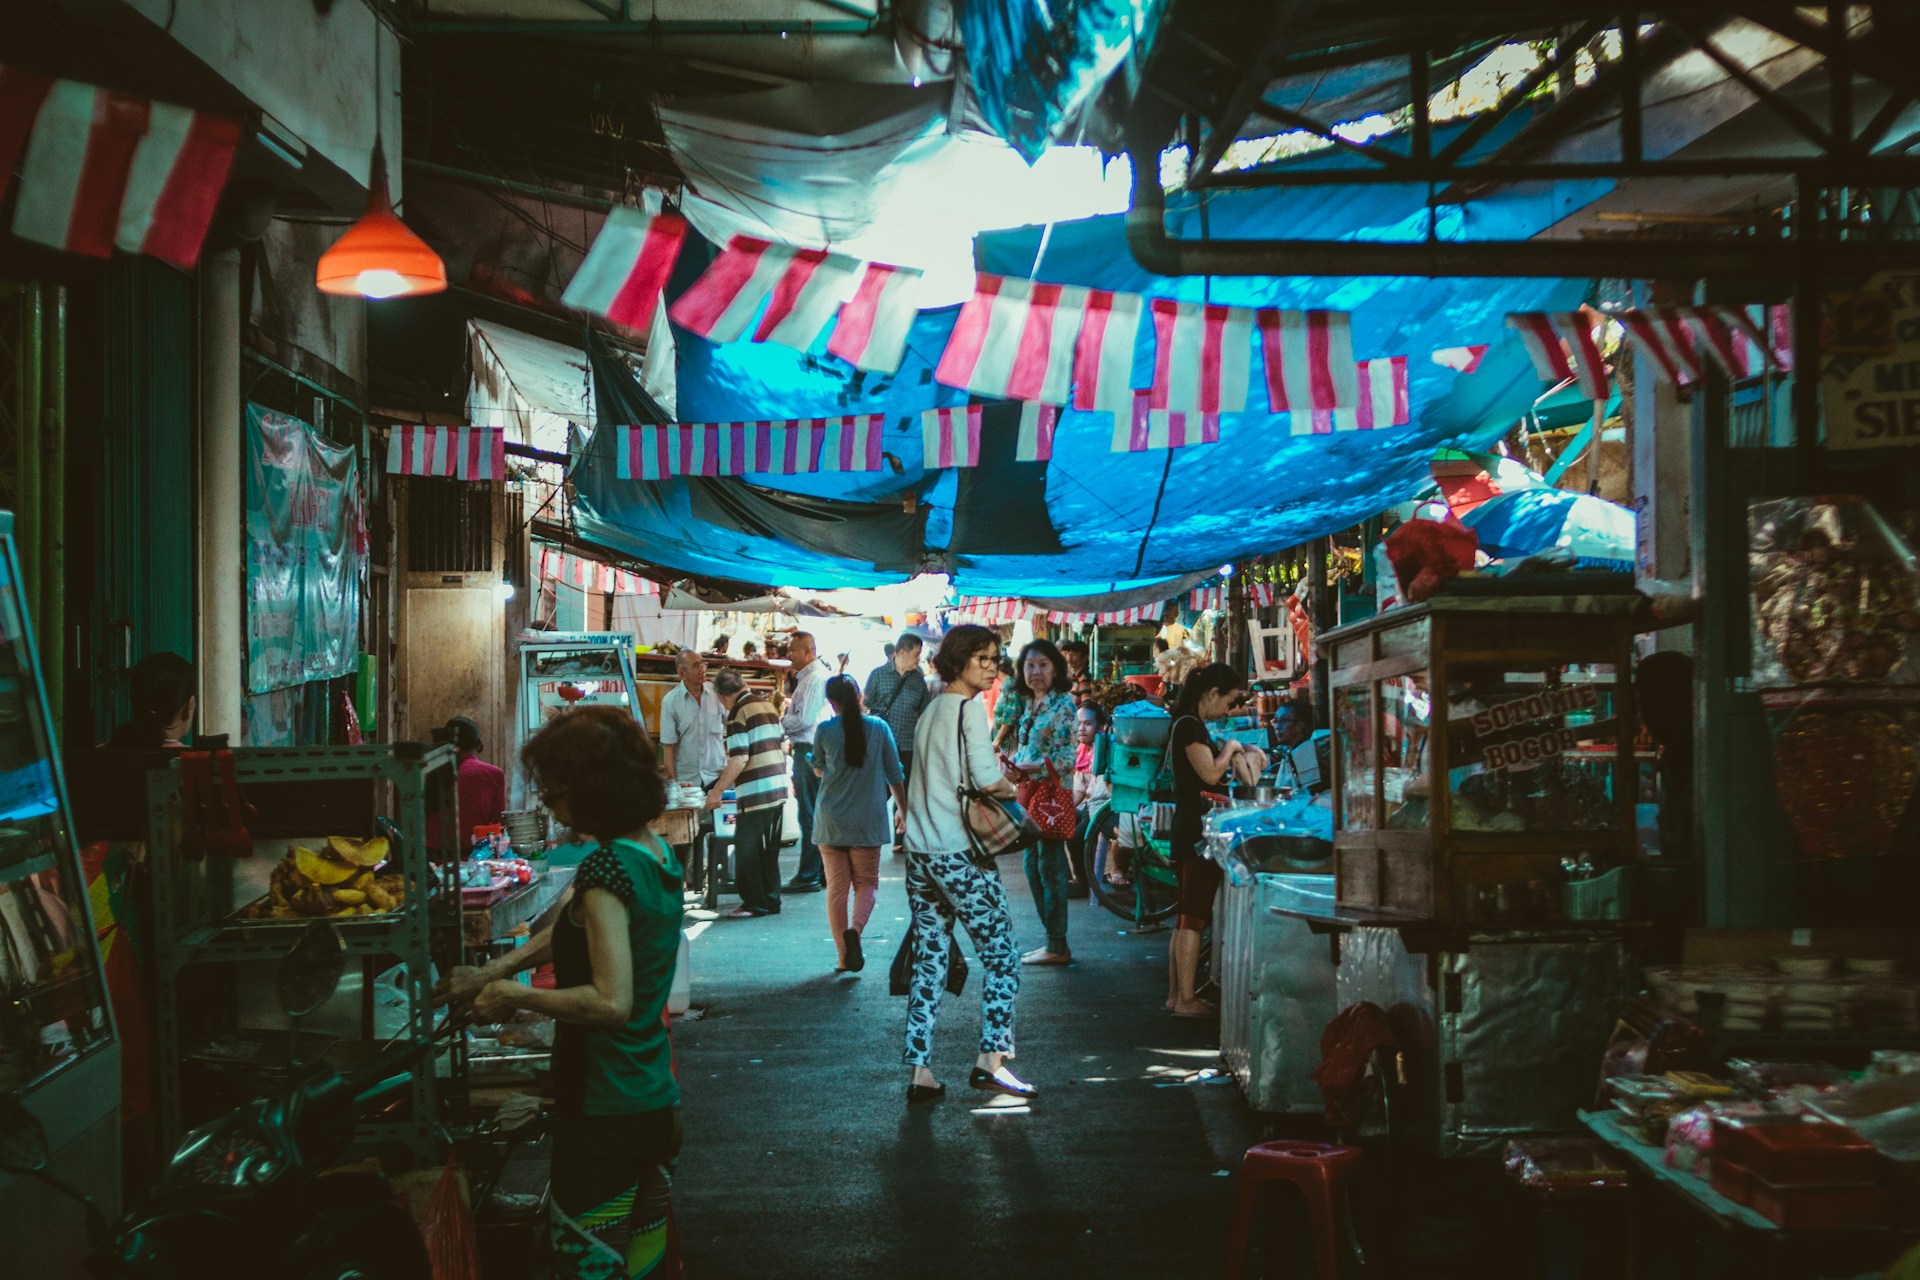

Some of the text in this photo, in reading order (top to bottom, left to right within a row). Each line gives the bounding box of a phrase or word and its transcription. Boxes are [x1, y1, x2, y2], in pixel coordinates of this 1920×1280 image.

[1835, 298, 1889, 346] 12
[1473, 685, 1597, 737] SOTO MIE
[1484, 728, 1575, 770] BOGOR
